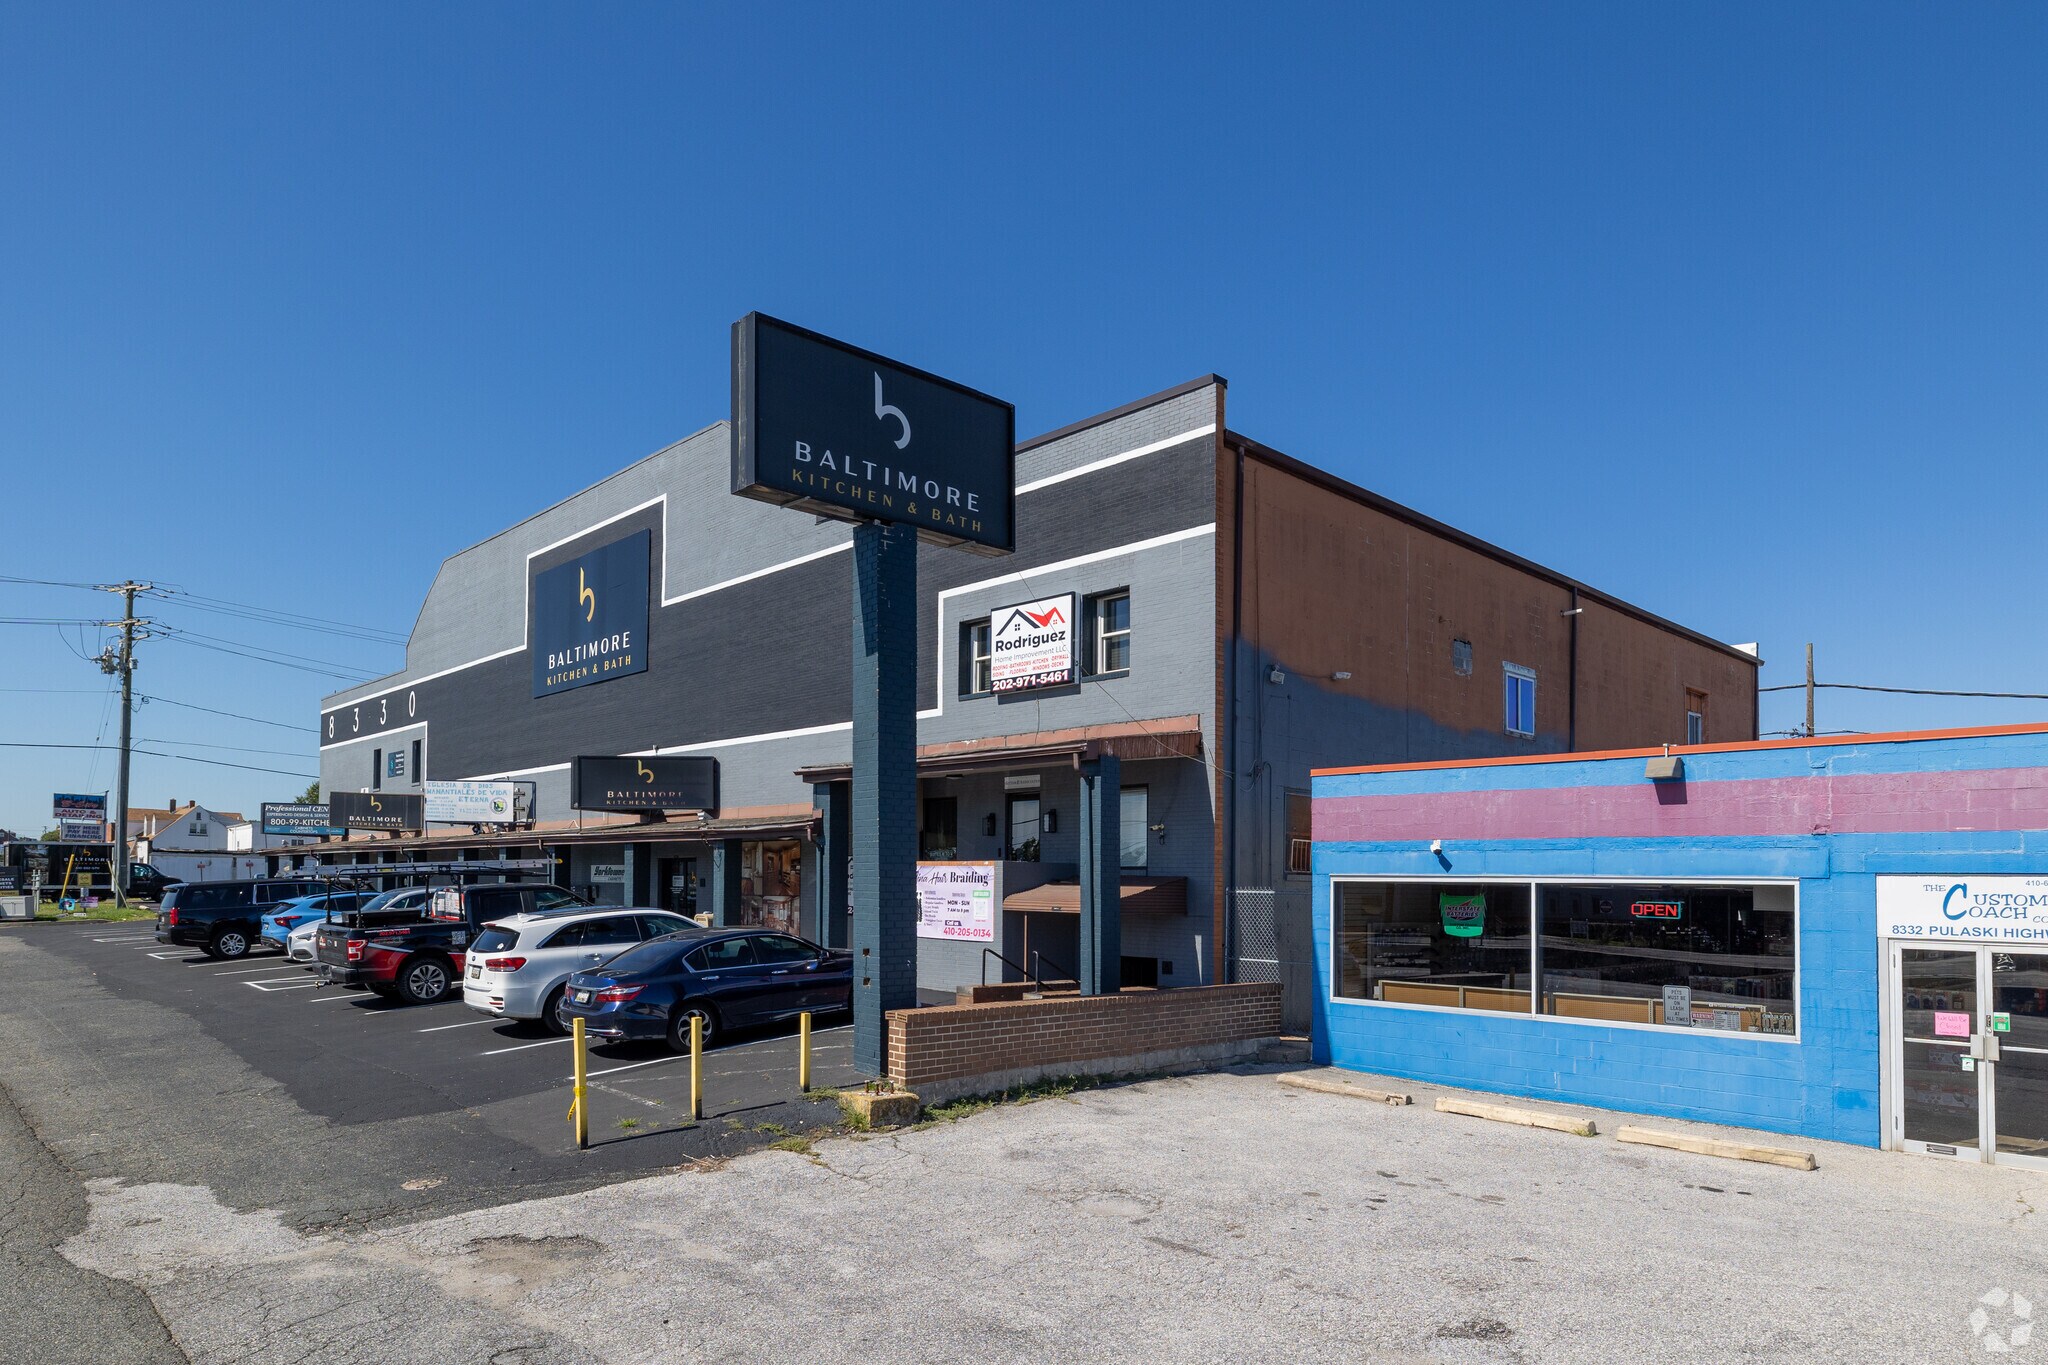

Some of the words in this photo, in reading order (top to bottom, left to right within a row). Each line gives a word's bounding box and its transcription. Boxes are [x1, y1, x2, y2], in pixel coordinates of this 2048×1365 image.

[795, 440, 980, 512] BALTIMORE
[792, 468, 893, 507] KITCHEN
[907, 501, 918, 515] &
[932, 508, 981, 533] BATH
[995, 630, 1066, 652] Rodriguez
[548, 631, 631, 670] BALTIMORE
[1014, 648, 1055, 660] Improvement
[547, 667, 587, 686] KITCHEN
[604, 655, 632, 671] BATH
[992, 670, 1069, 691] 202-971-5461
[265, 805, 312, 813] Professional
[349, 815, 402, 823] BALTIMORE
[950, 871, 989, 887] Braiding
[1923, 884, 1946, 892] THE
[1631, 903, 1677, 917] OPEN
[943, 927, 991, 938] 410-205-0134
[1892, 925, 1923, 935] 8332
[1929, 926, 1998, 937] PULASKI
[2004, 928, 2048, 939] HIGH
